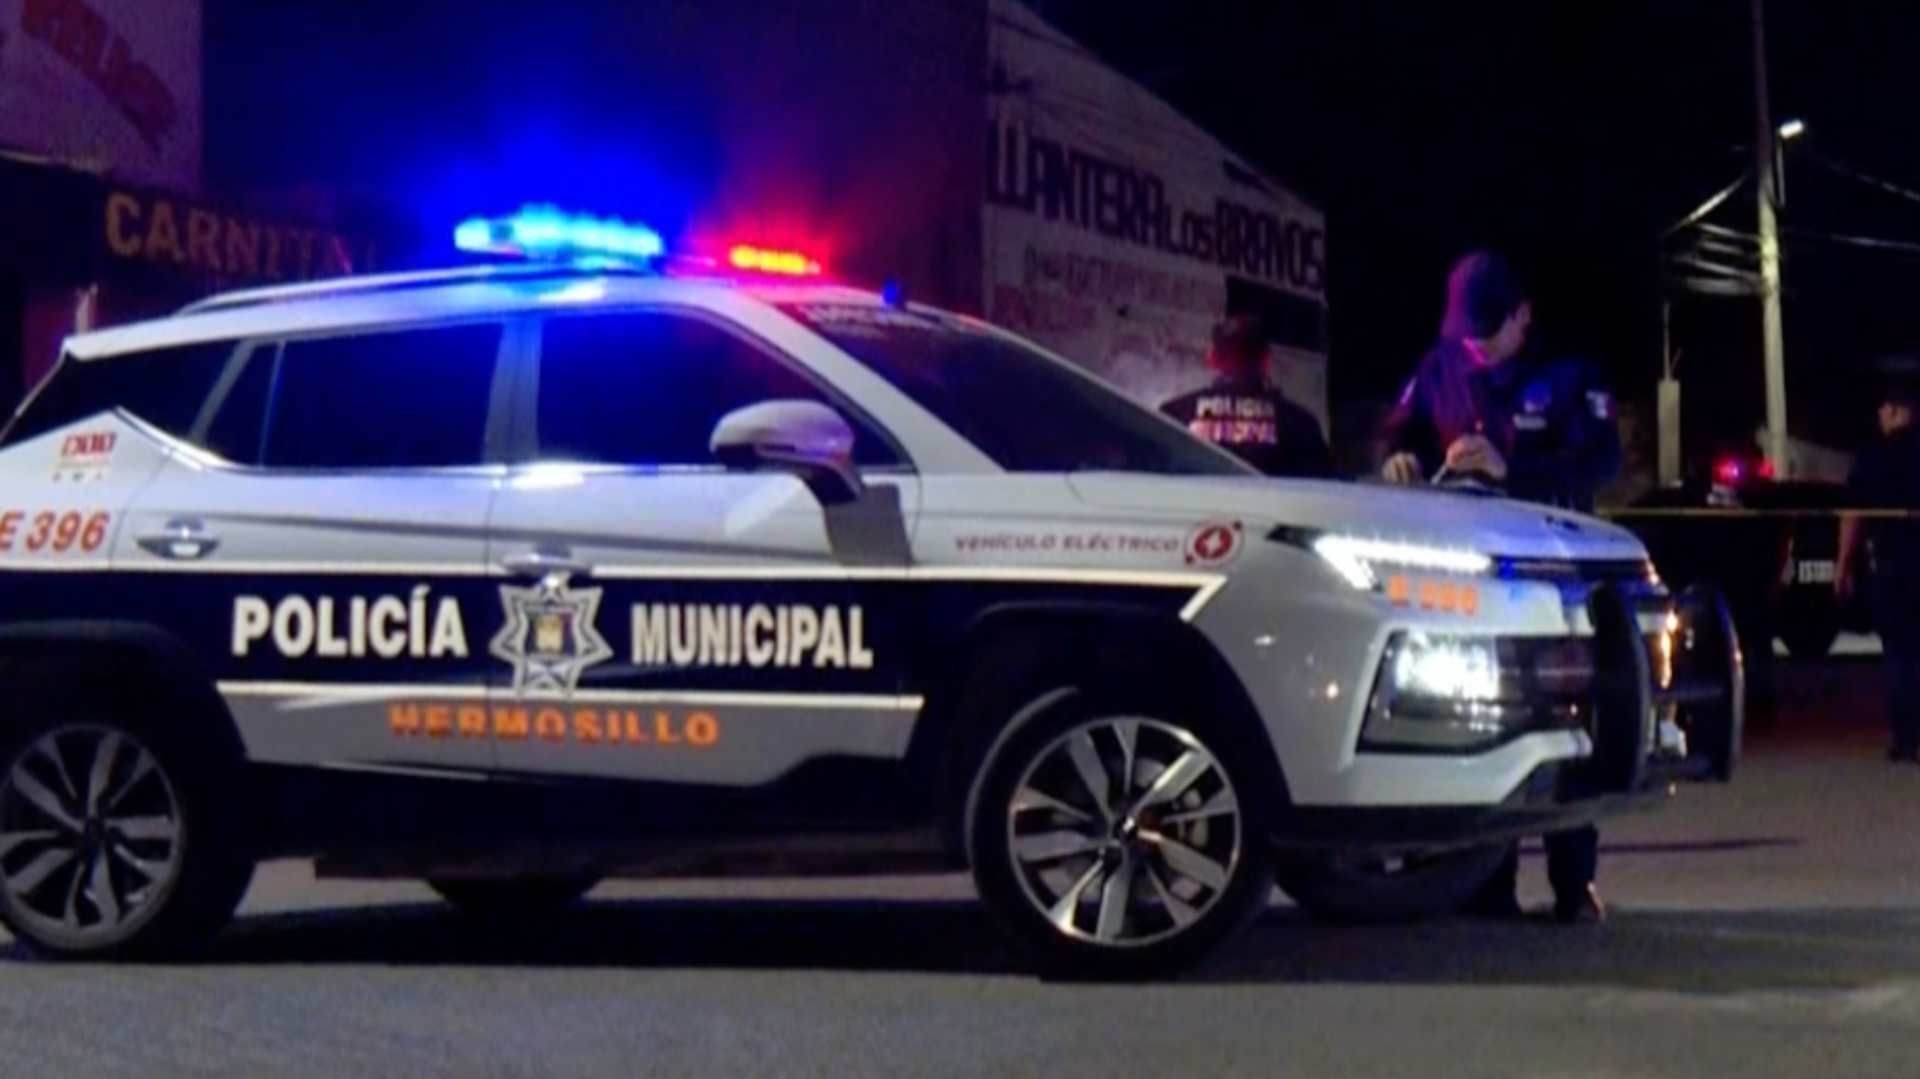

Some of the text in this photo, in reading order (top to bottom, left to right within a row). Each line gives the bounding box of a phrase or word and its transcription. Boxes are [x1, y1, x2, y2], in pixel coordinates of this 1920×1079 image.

[985, 118, 1164, 248] LLANTERA
[1164, 203, 1216, 262] LOS
[106, 192, 378, 279] CARNITA
[0, 509, 110, 553] E 396
[231, 584, 874, 669] POLICÍA MUNICIPAL
[389, 702, 719, 745] HERMOSILLO
